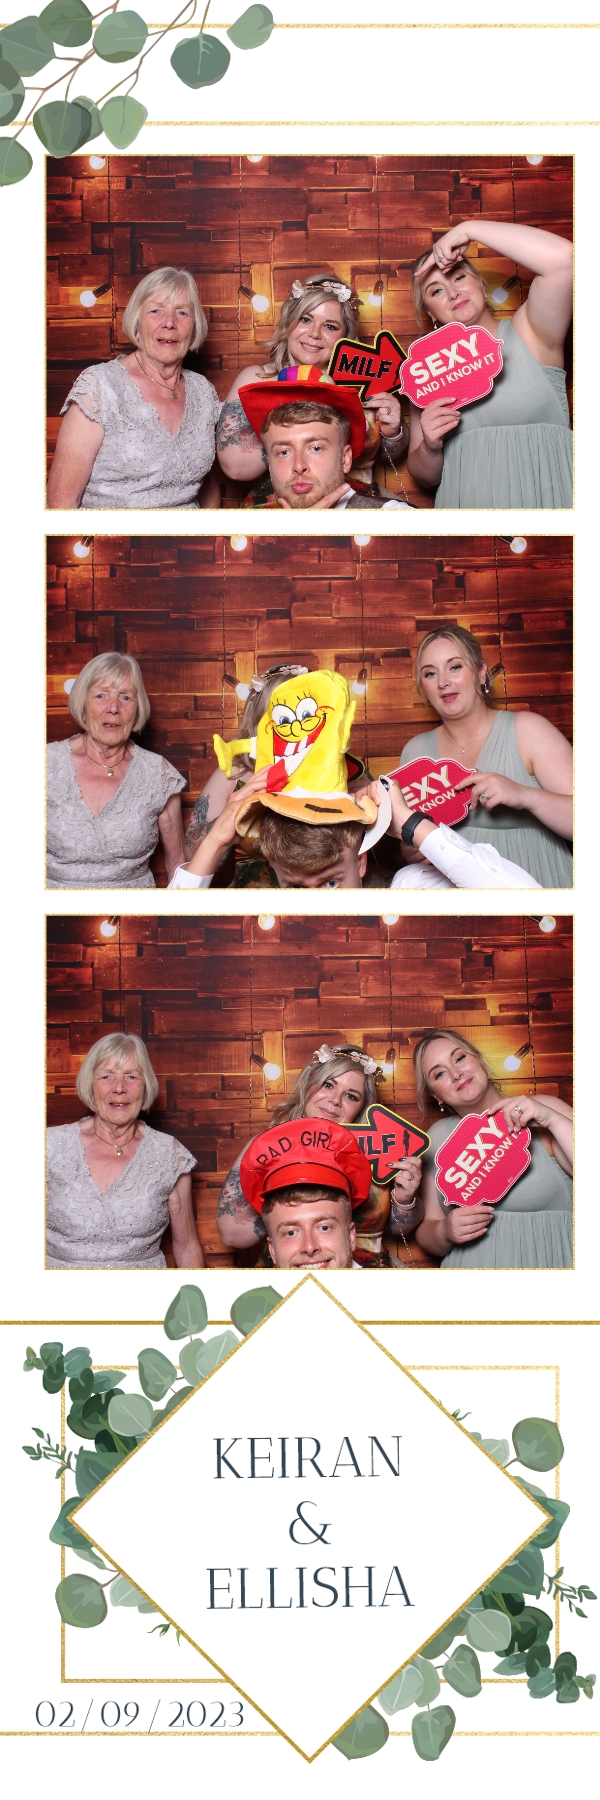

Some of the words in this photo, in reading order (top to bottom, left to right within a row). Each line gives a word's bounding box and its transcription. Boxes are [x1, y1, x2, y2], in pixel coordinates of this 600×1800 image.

[337, 353, 393, 379] MILF
[409, 332, 479, 385] SEXY
[416, 381, 440, 399] AND
[441, 377, 447, 386] I
[446, 359, 483, 384] KNOW
[484, 352, 496, 366] IT
[401, 764, 452, 808] EXY
[419, 788, 457, 813] KNOW
[300, 1130, 334, 1152] GIRL
[357, 1132, 396, 1156] ILF
[444, 1116, 504, 1189] SEXY
[482, 1136, 513, 1172] KNOW
[479, 1170, 487, 1178] I
[461, 1176, 482, 1201] AND
